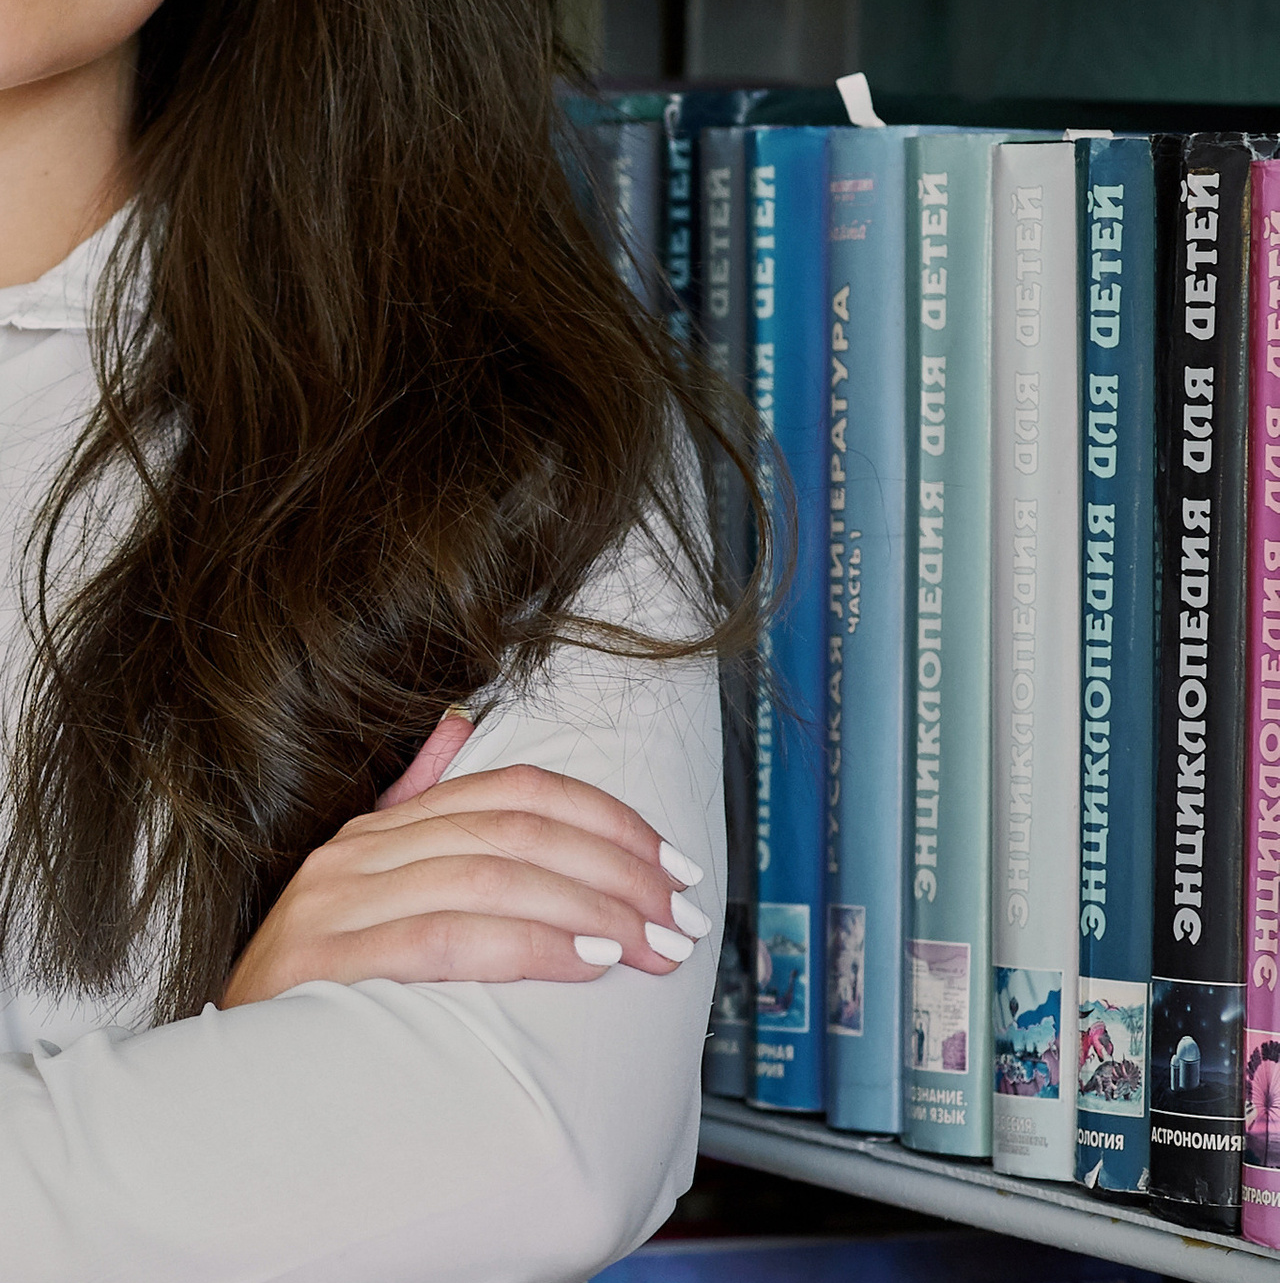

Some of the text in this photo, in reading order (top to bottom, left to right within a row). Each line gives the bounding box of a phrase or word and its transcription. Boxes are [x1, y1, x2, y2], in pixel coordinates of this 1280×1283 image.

[829, 284, 851, 619] ЛИТЕРАТУРА
[847, 547, 862, 635] ЧАСТЬ
[913, 171, 949, 903] ЭНЦИКЛОПЕДИЯ ДЛЯ ДЕТЕЙ
[1007, 184, 1044, 929] ЭНЦИКЛОПЕДИЯ ДЛЯ ДЕТЕЙ
[1080, 183, 1125, 942] ЭНЦИКЛОПЕДИЯ ДЛЯ ДЕТЕЙ
[1172, 171, 1221, 947] ЭНЦИКЛОПЕДИЯ ДЛЯ ДЕТЕЙ
[1259, 406, 1280, 518] ДЛЯ
[1250, 539, 1280, 993] ЭНЦИКЛОПЕДИЯ
[929, 1107, 966, 1126] ЯЗЫК
[1151, 1125, 1242, 1152] АСТРОНОМИЯ
